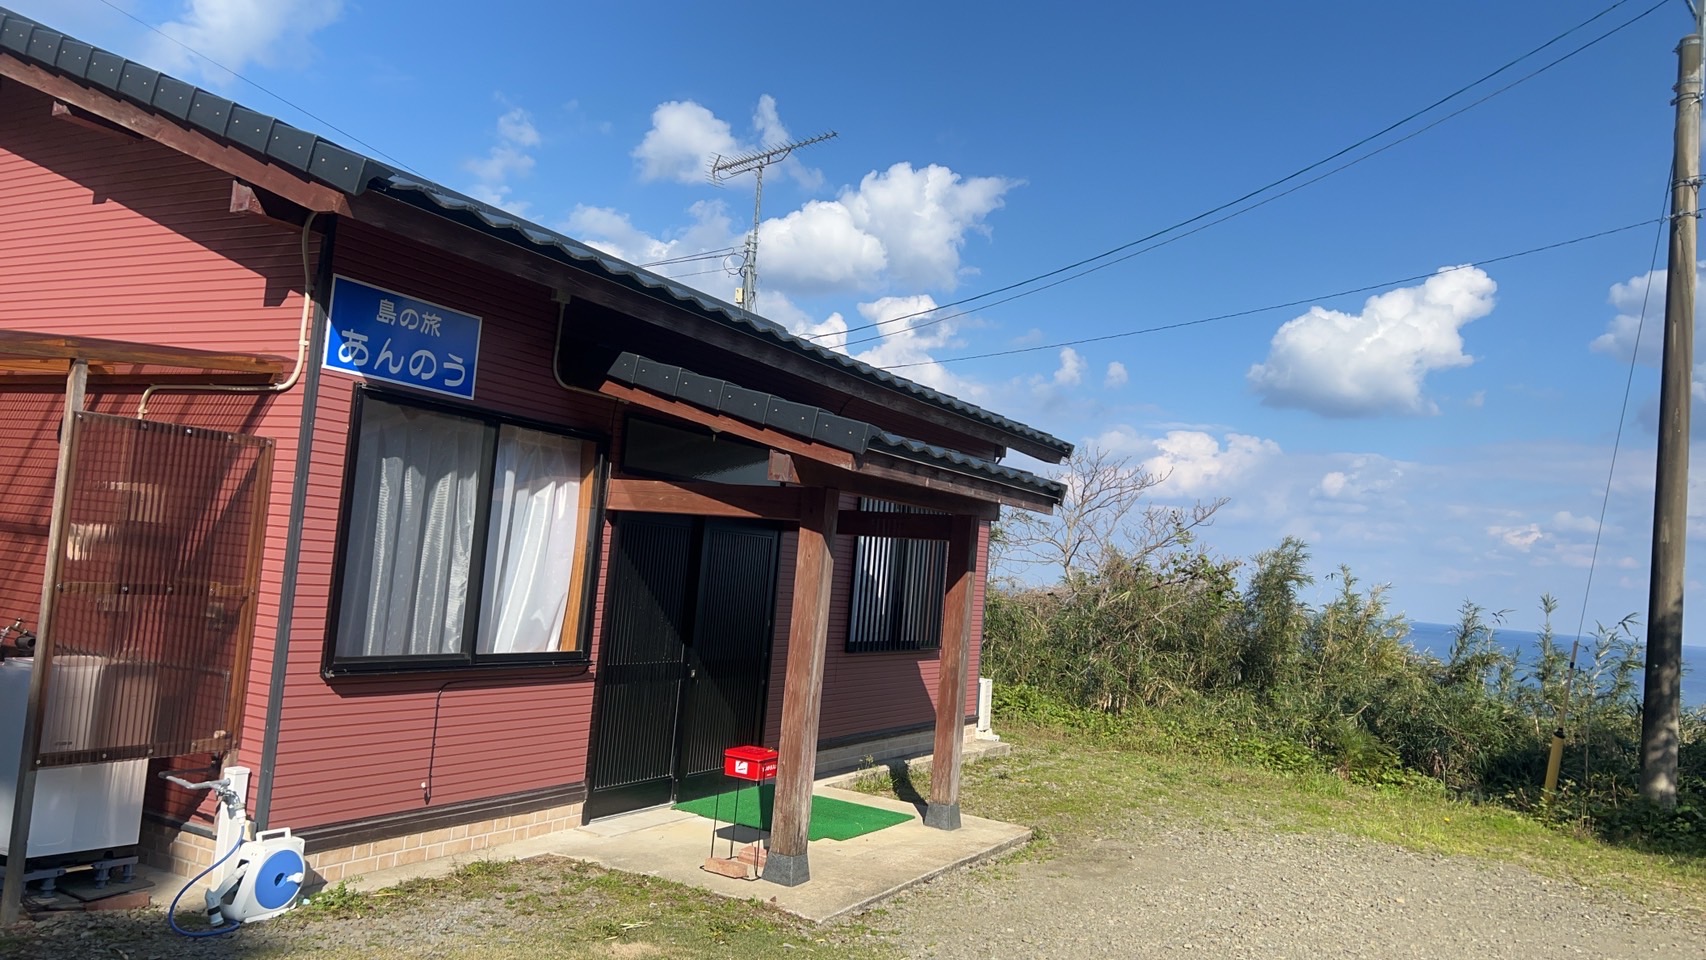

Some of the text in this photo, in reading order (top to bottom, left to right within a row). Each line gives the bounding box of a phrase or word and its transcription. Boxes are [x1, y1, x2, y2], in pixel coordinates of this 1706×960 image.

[376, 298, 442, 337] 島の旅
[337, 328, 466, 387] あんのう
